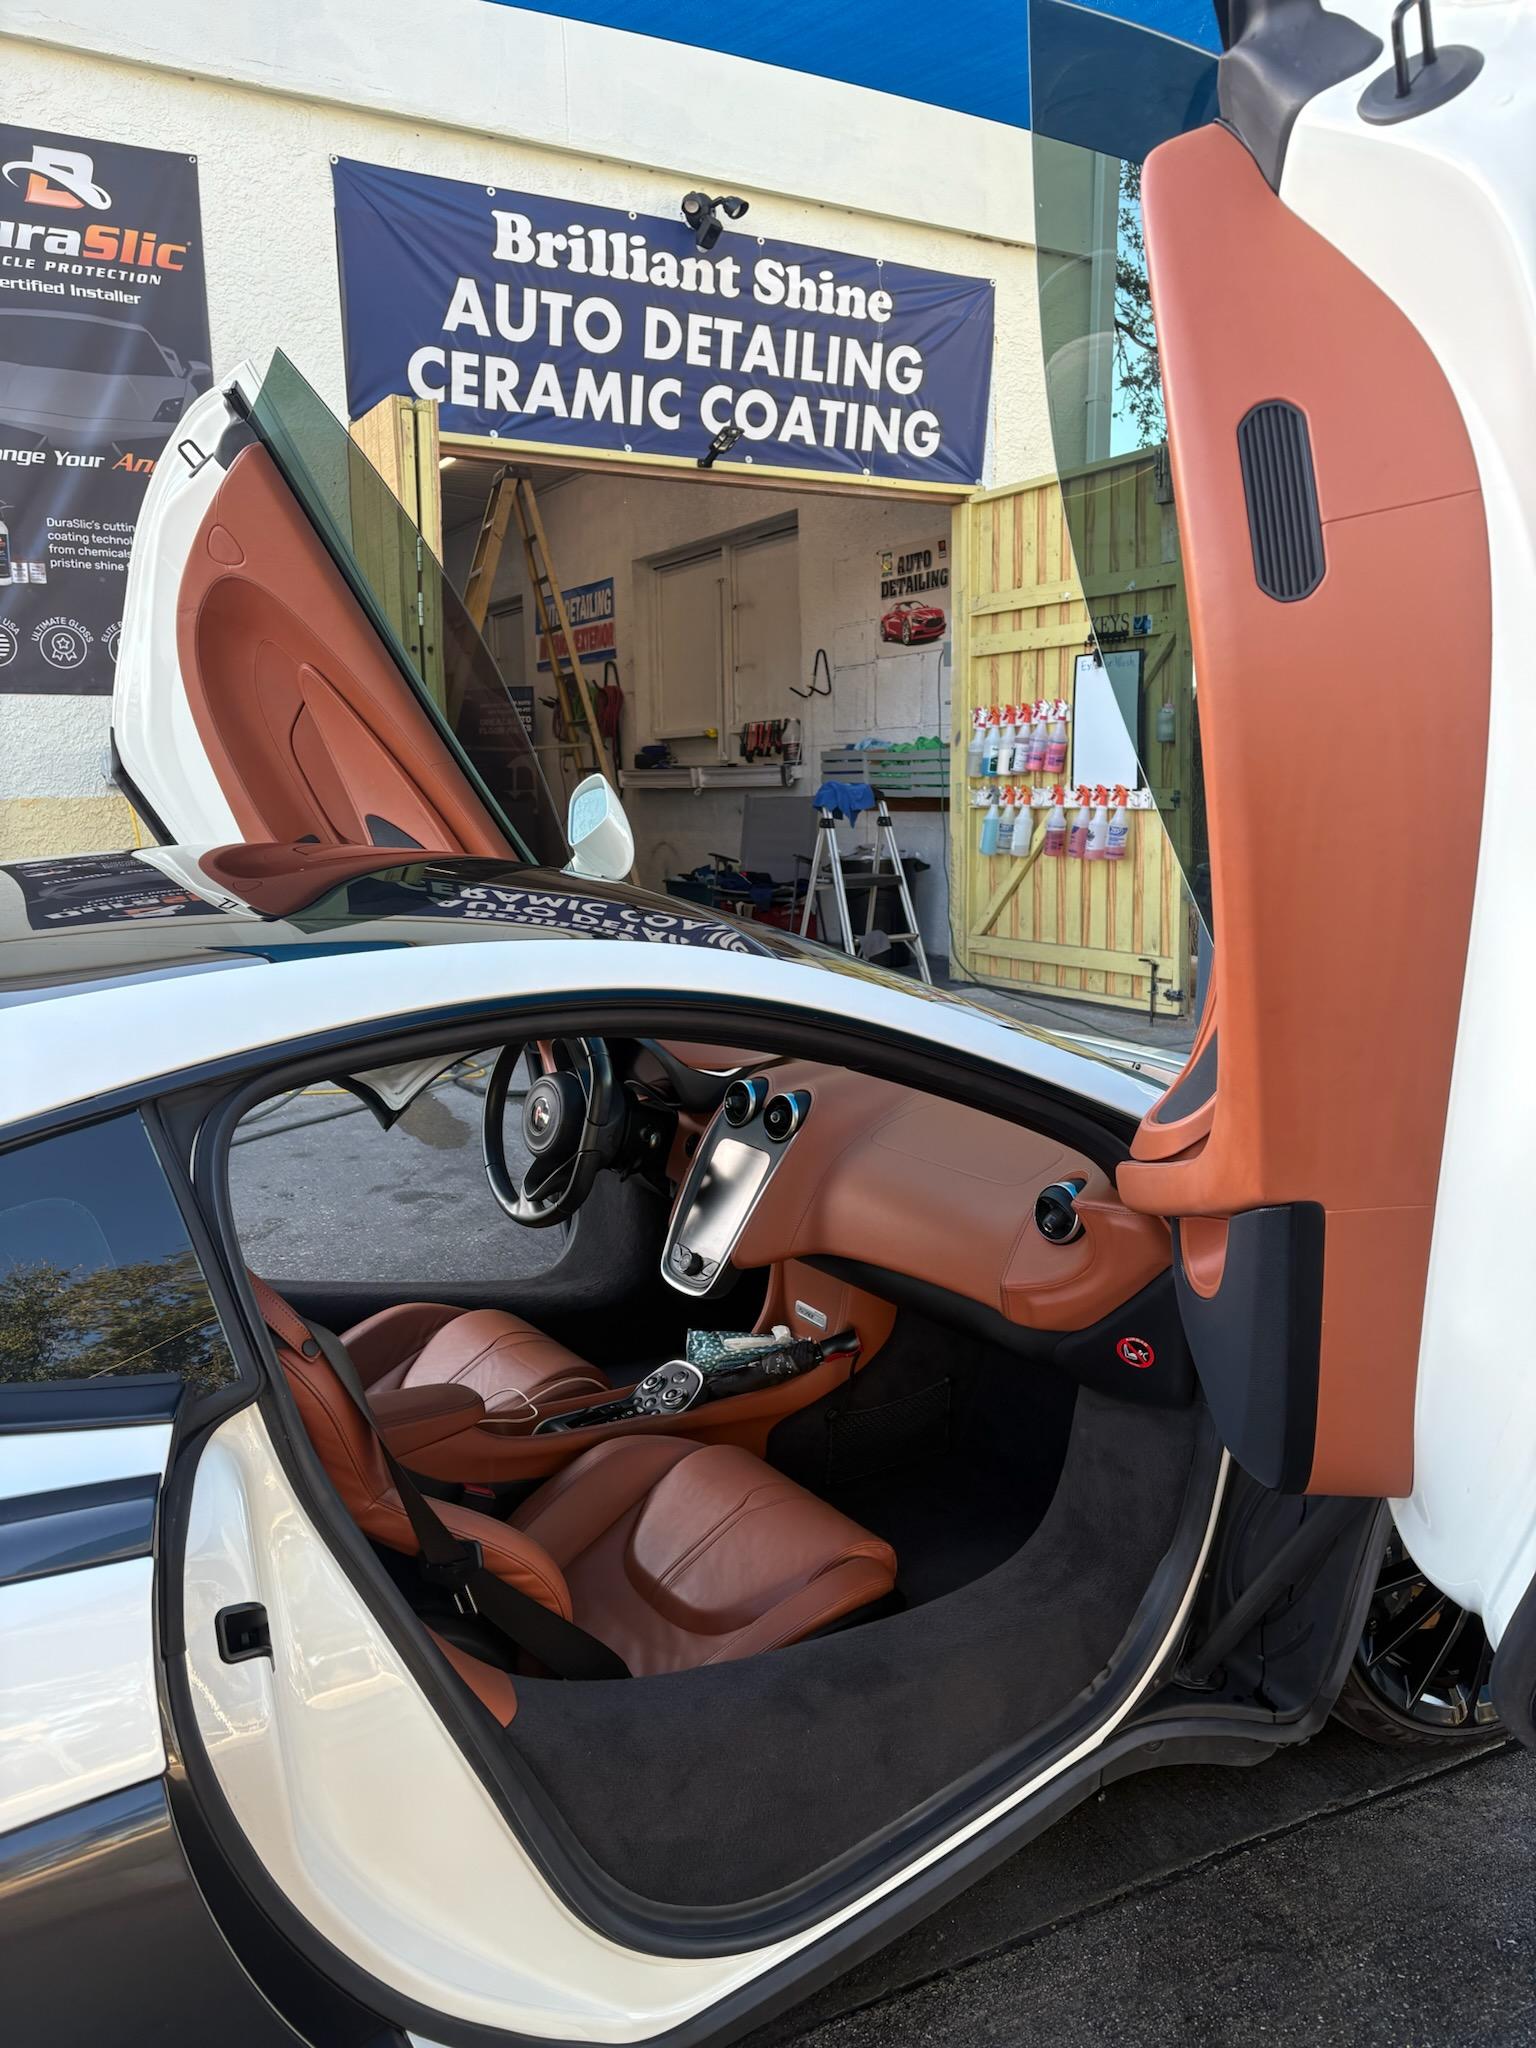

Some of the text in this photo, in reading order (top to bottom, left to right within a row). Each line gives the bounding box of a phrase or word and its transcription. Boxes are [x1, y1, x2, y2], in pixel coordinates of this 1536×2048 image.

[44, 260, 162, 285] PROTECTION
[490, 209, 894, 324] Brilliant Shine
[70, 284, 142, 305] Installer
[441, 277, 925, 396] AUTO DETAILING
[406, 345, 942, 459] CERAMIC COATING
[54, 450, 105, 468] Your
[46, 516, 101, 531] DuraSlic's
[47, 531, 90, 545] coating
[48, 543, 76, 556] from
[50, 557, 125, 572] pristine shine
[897, 549, 932, 576] AUTO
[881, 567, 949, 600] DETAILING
[2, 617, 20, 635] USA
[31, 616, 94, 643] ULTIMATE GLOSS
[100, 623, 118, 643] ELITE
